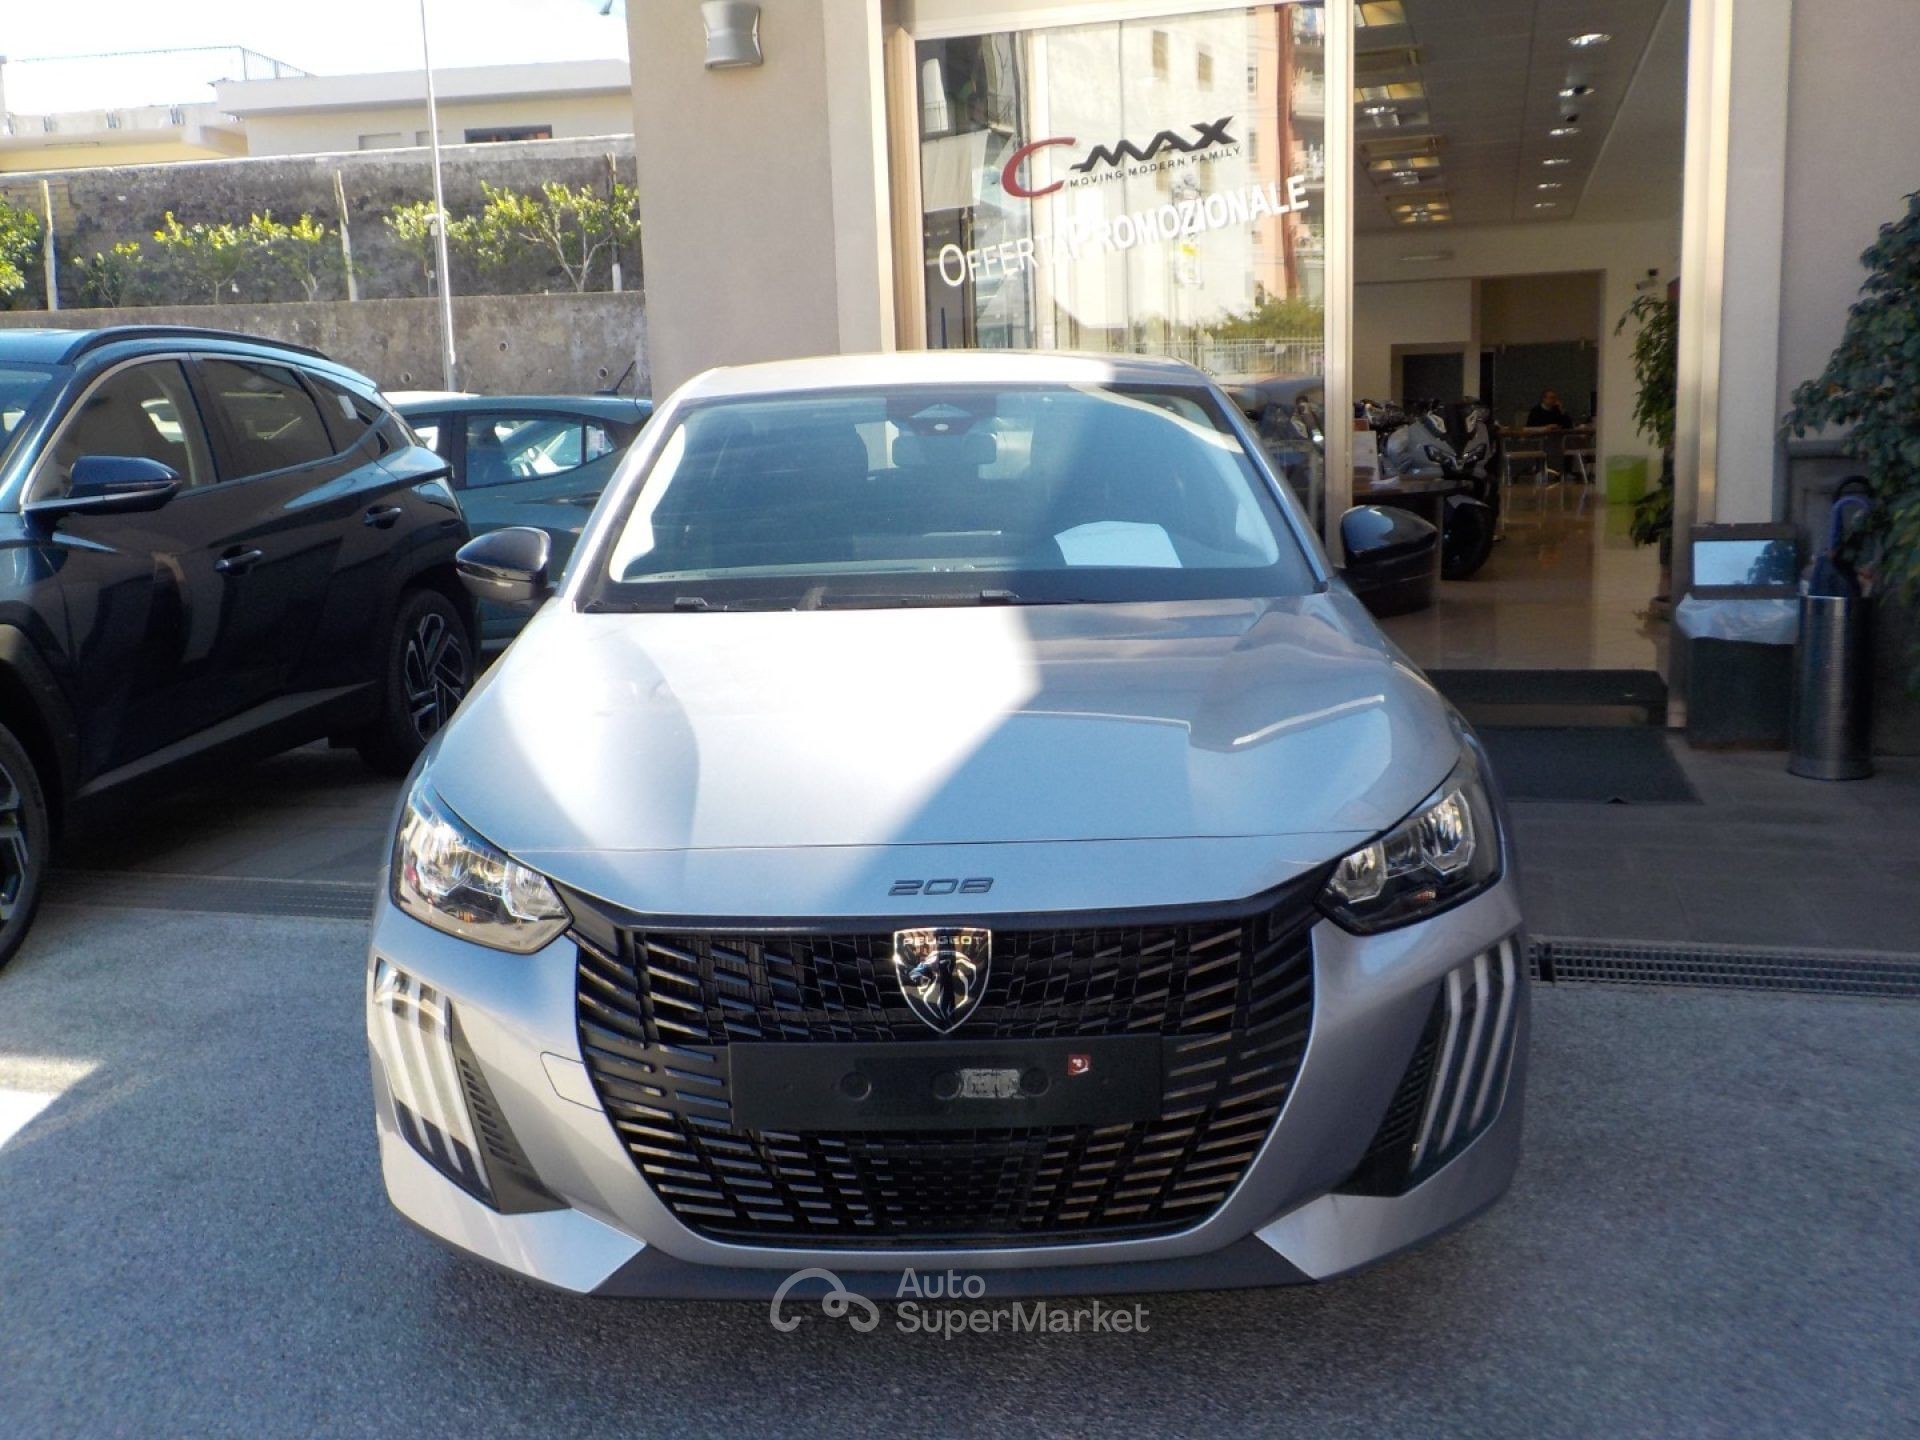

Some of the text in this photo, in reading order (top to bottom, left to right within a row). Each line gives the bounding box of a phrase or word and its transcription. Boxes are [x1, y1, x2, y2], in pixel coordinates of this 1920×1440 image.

[1070, 146, 1241, 188] MOVING MODERN FAMILY
[888, 877, 994, 896] 208
[903, 936, 984, 946] PEUGEOT
